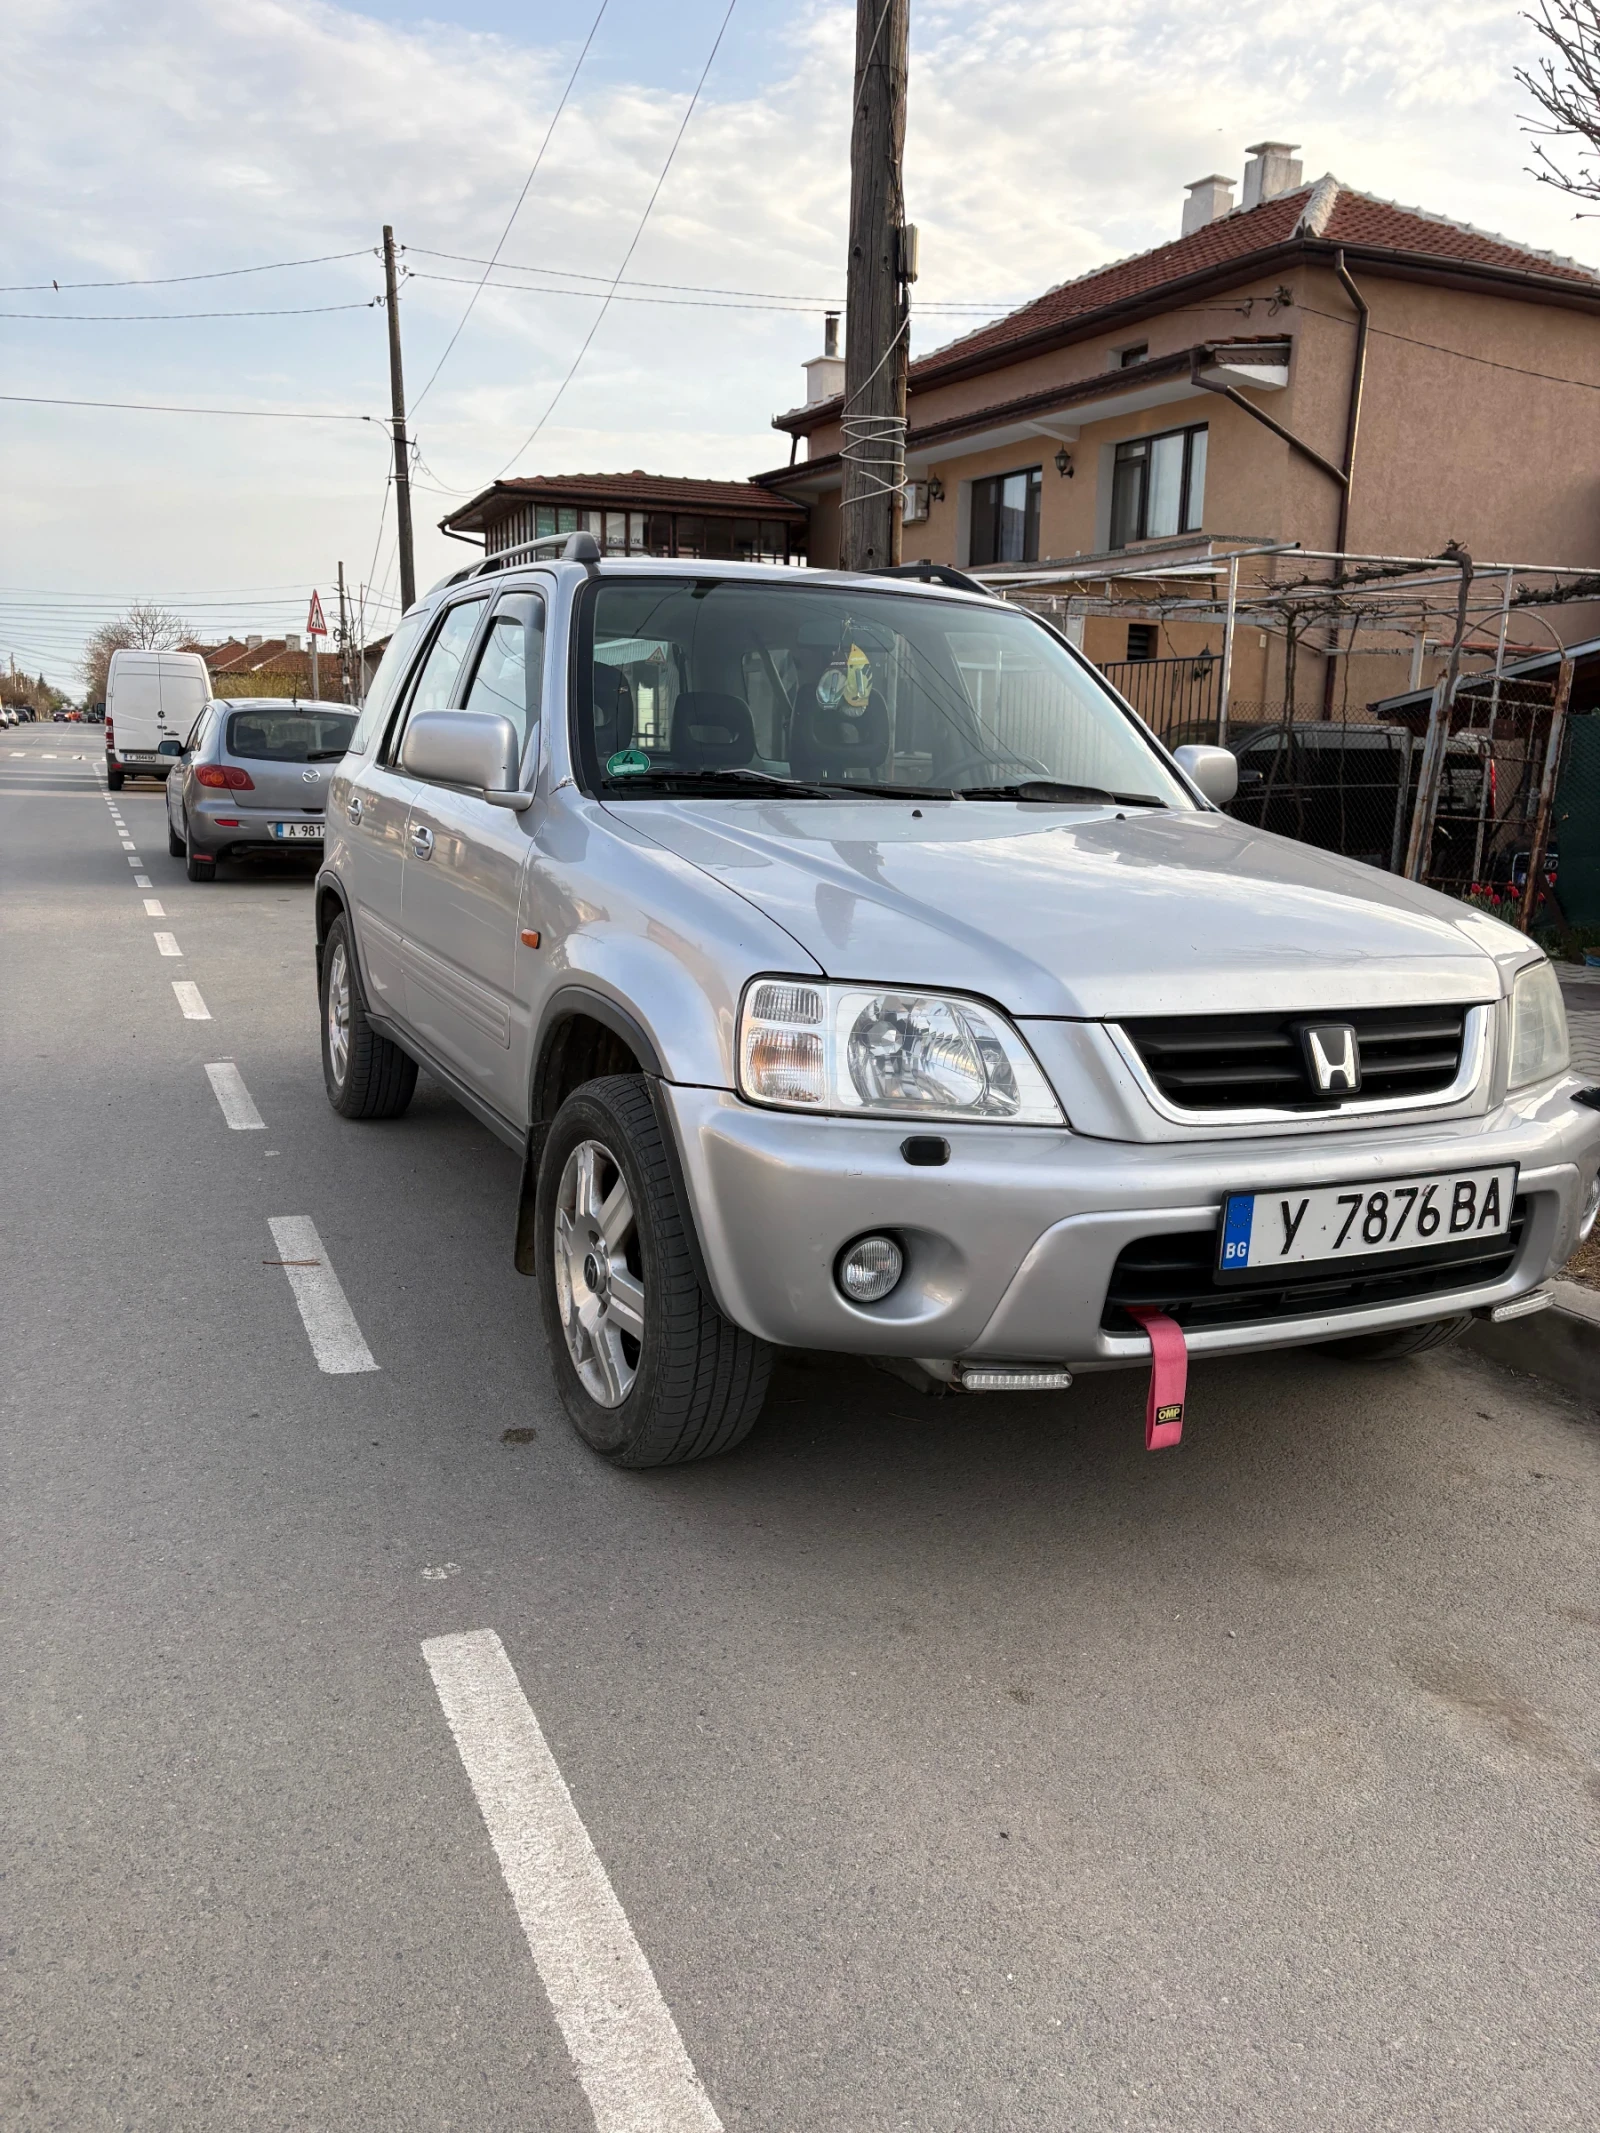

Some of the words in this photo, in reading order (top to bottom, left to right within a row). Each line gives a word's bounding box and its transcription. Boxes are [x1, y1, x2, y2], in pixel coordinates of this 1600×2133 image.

[622, 751, 634, 764] 4
[289, 825, 296, 836] A
[1332, 1184, 1441, 1249] 7876
[1449, 1176, 1501, 1234] BA
[1225, 1241, 1247, 1260] BG
[1158, 1408, 1180, 1420] OMP
